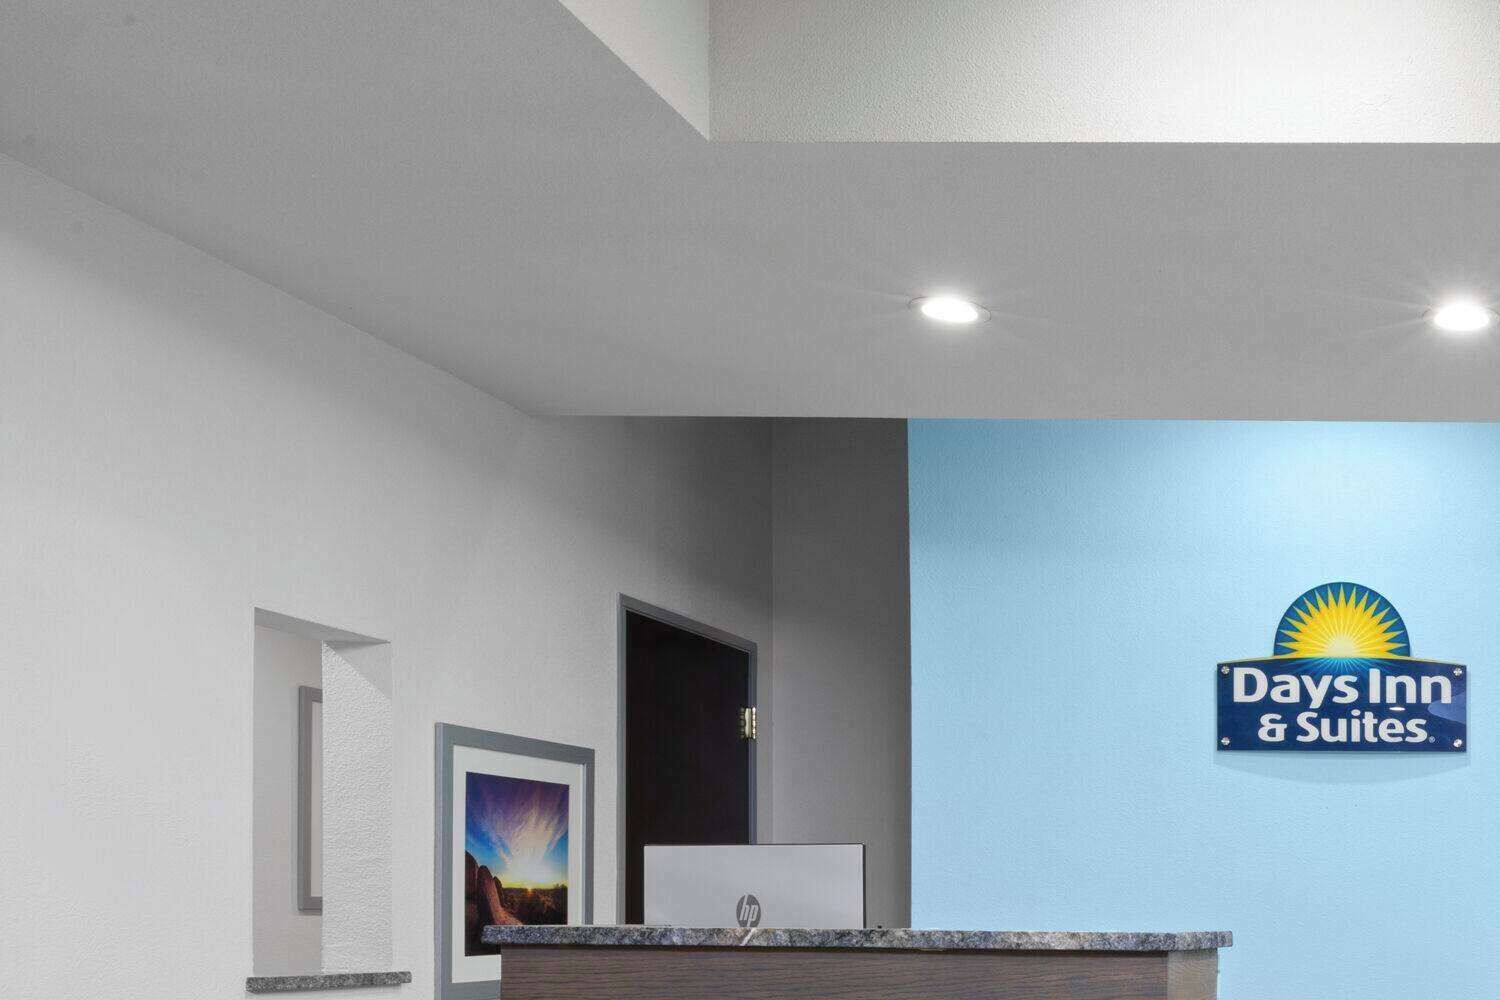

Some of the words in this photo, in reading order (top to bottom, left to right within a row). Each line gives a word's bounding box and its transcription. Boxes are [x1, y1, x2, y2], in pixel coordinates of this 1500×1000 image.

[1233, 667, 1359, 709] Days
[1369, 668, 1452, 704] Inn
[1257, 713, 1288, 742] &
[1296, 709, 1428, 743] Suites
[738, 895, 760, 927] hp
